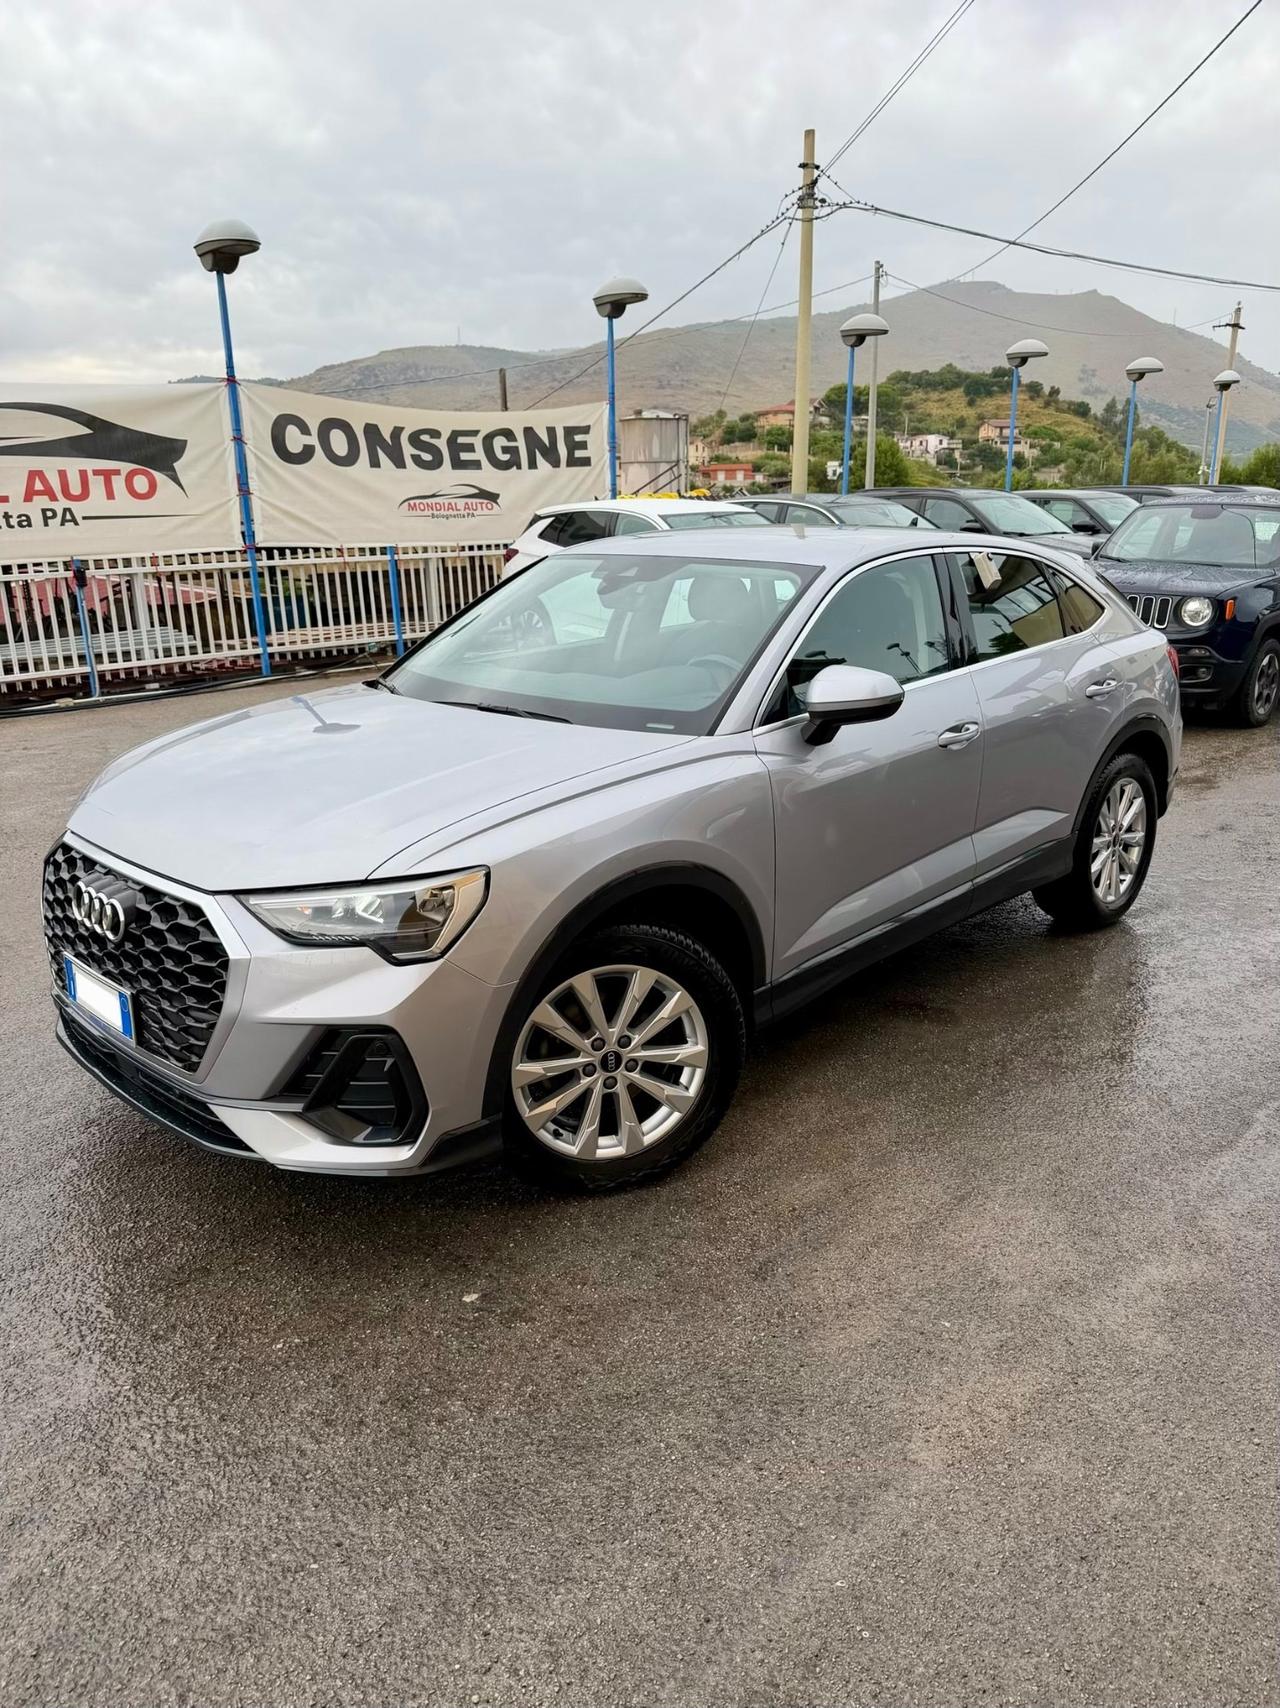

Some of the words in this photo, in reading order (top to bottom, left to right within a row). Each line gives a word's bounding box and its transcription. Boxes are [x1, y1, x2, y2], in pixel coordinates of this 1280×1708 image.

[270, 413, 592, 471] CONSEGNE
[23, 468, 158, 503] AUTO
[0, 511, 33, 529] ta
[41, 507, 80, 527] PA
[407, 502, 461, 512] MONDIAL
[463, 501, 494, 512] AUTO
